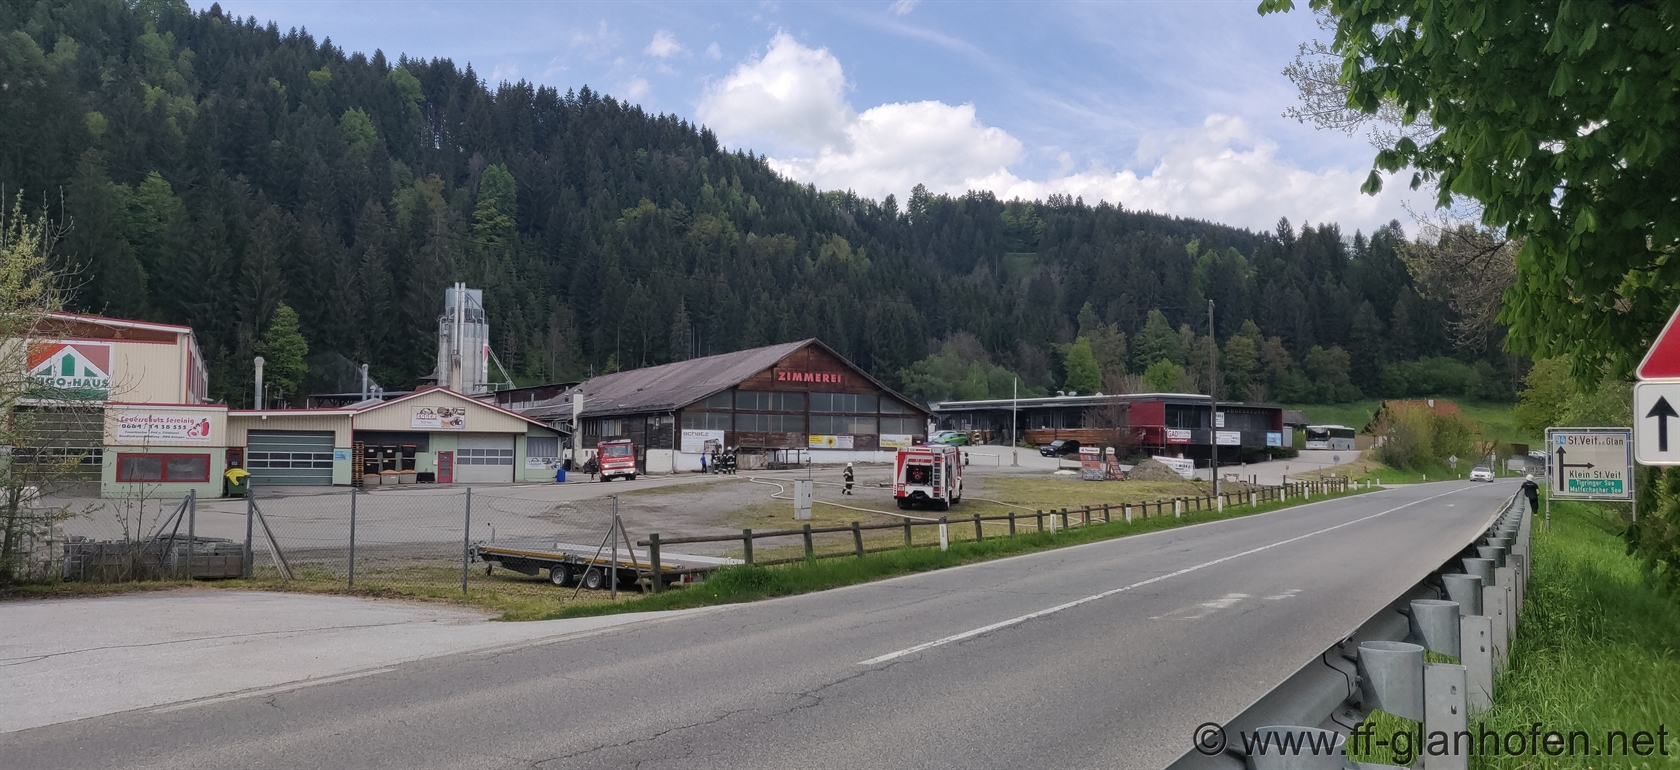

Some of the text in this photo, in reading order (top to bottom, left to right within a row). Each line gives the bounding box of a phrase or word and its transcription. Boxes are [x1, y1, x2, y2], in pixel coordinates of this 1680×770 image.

[778, 371, 842, 383] ZIMMEREI
[1167, 430, 1179, 438] GAD
[1606, 437, 1624, 446] Glan
[1569, 470, 1590, 478] Klein
